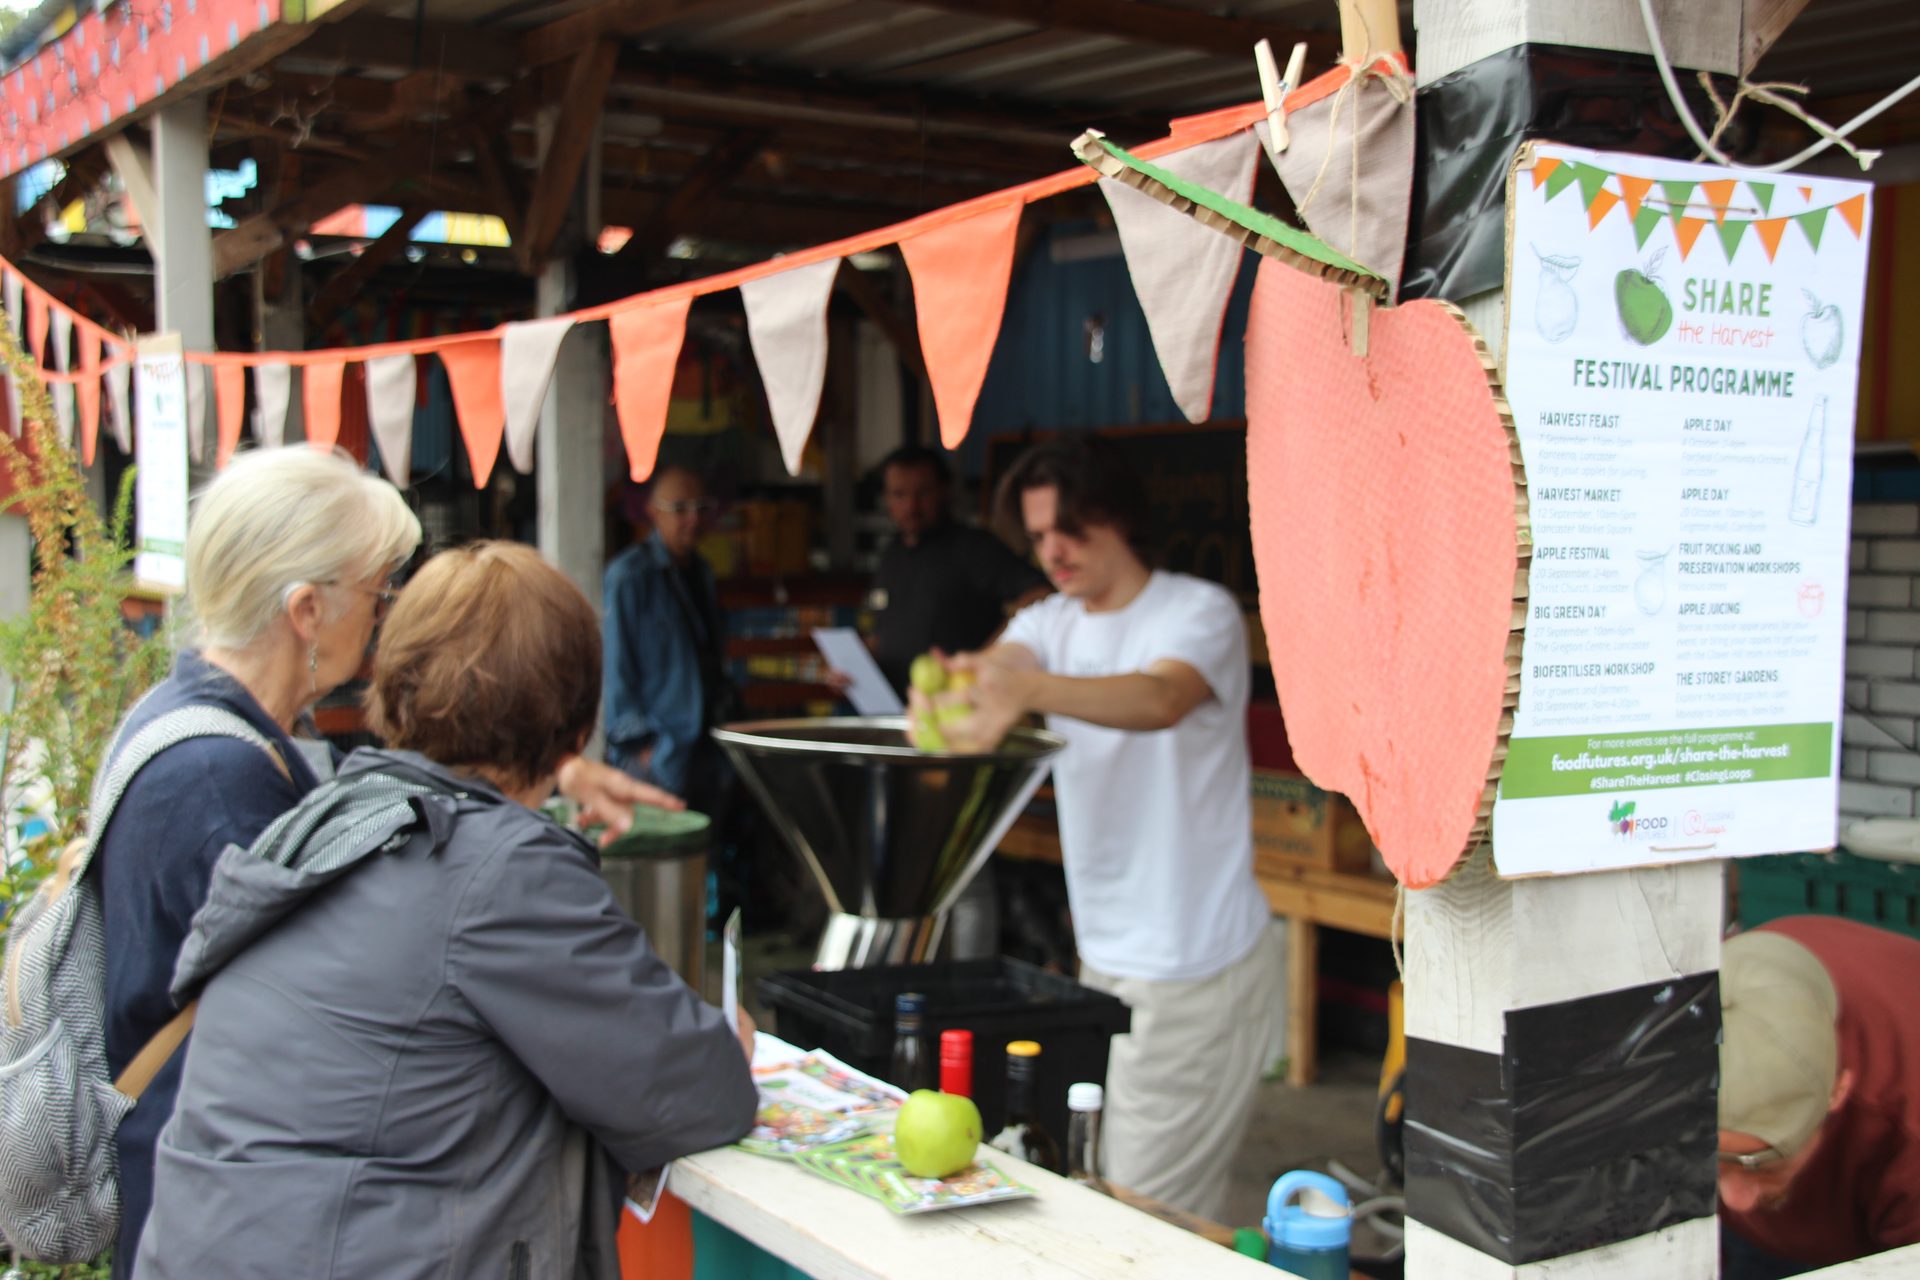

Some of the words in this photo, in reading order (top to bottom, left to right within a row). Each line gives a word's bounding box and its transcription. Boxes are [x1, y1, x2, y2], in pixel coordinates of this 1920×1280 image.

[1683, 277, 1773, 318] SHARE
[1678, 321, 1702, 342] the
[1711, 321, 1776, 348] Harvest
[1574, 359, 1663, 392] FESTIVAL
[1671, 365, 1795, 398] PROGRAMME
[1539, 411, 1587, 428] HARVEST
[1589, 413, 1620, 429] FEAST
[1683, 418, 1712, 432] APPLE
[1713, 419, 1733, 432] DAY
[1537, 487, 1582, 501] HARVEST
[1583, 488, 1622, 502] MARKET
[1680, 487, 1709, 501] APPLE
[1711, 488, 1729, 501] DAY
[1536, 546, 1568, 560] APPLE
[1569, 547, 1611, 560] FESTIVAL
[1679, 542, 1703, 555] FRUIT
[1705, 542, 1741, 556] PICKING
[1743, 543, 1762, 556] AND
[1678, 561, 1744, 574] PRESERVATION
[1746, 561, 1801, 575] WORKSHOPS
[1534, 605, 1551, 619] BIG
[1553, 605, 1585, 619] GREEN
[1587, 605, 1607, 618] DAY
[1678, 602, 1706, 615] APPLE
[1707, 602, 1740, 615] JUICING
[1533, 663, 1602, 679] BIOFERTILISER
[1604, 662, 1656, 677] WORKSHOP
[1676, 671, 1694, 686] THE
[1695, 671, 1732, 685] STOREY
[1734, 669, 1779, 684] GARDENS
[1587, 739, 1601, 750] For
[1602, 739, 1625, 749] more
[1626, 736, 1653, 747] events
[1654, 736, 1669, 746] see
[1670, 735, 1683, 745] the
[1684, 733, 1697, 743] full
[1698, 732, 1744, 746] programme
[1552, 743, 1789, 771] foodfutures.org.uk/share-the-harvest
[1590, 773, 1681, 790] #ShareTheHarvest
[1684, 769, 1753, 783] #ClosingLoops
[1635, 816, 1668, 830] FOOD
